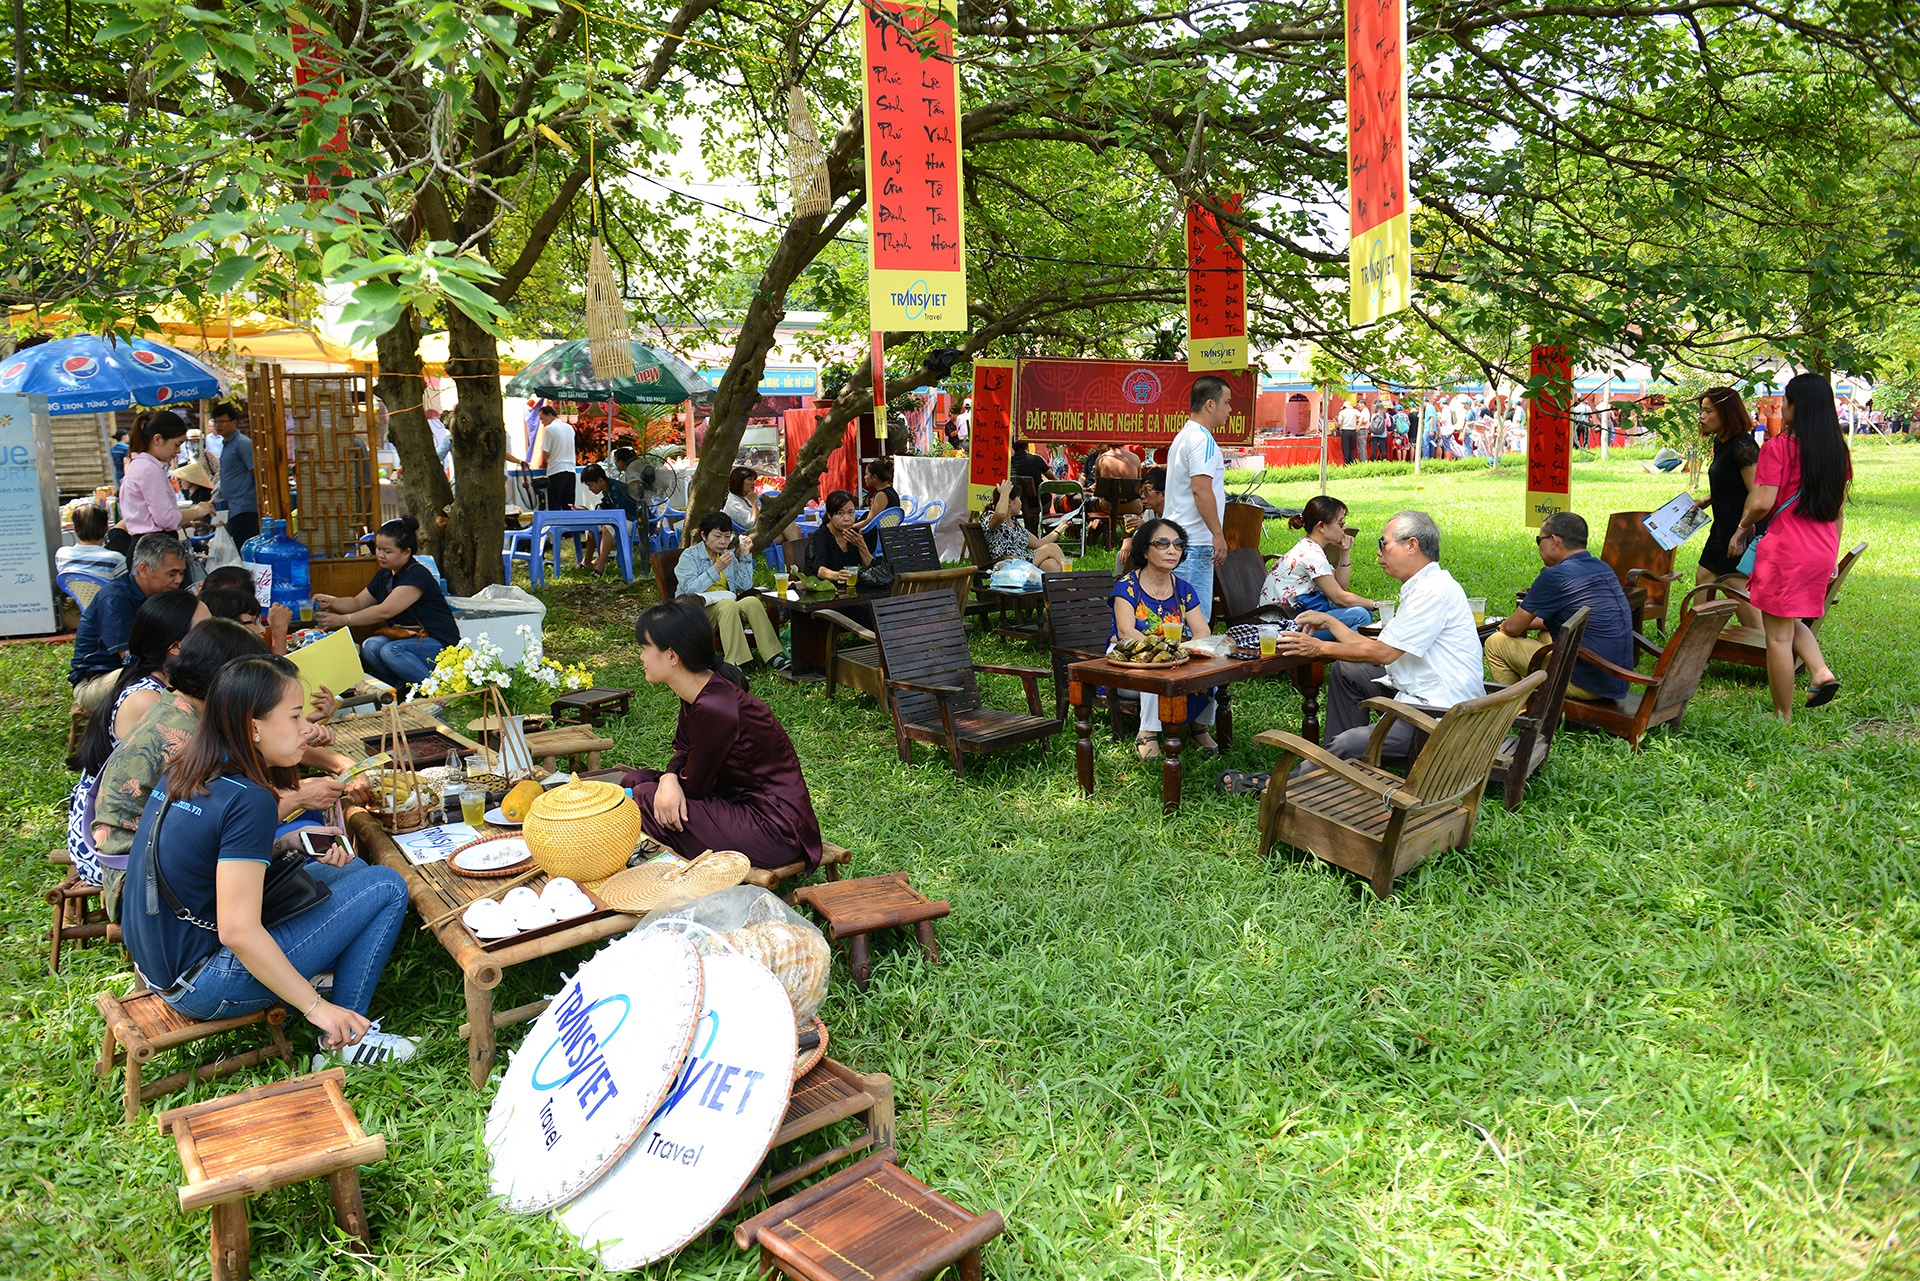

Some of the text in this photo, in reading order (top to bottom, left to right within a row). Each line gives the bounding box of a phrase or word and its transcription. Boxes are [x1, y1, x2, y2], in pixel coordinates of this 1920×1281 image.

[876, 94, 904, 113] Sinh
[877, 121, 904, 139] Phú
[882, 177, 904, 196] Gia
[1361, 254, 1395, 286] TRANSVIET
[890, 289, 947, 310] TRANSVIET
[1200, 348, 1235, 358] TRANSVIET
[57, 384, 92, 393] pepsi
[174, 386, 199, 399] pepsi
[1026, 407, 1047, 433] ĐẶC
[1050, 409, 1084, 432] TRƯNG
[1087, 409, 1114, 432] LÀNG
[1117, 407, 1144, 433] NGHỀ
[1147, 409, 1160, 433] CẢ
[1229, 411, 1246, 437] NỘI
[555, 982, 619, 1121] TRANSVIET
[539, 1097, 562, 1151] Travel
[646, 1132, 704, 1168] Travel
